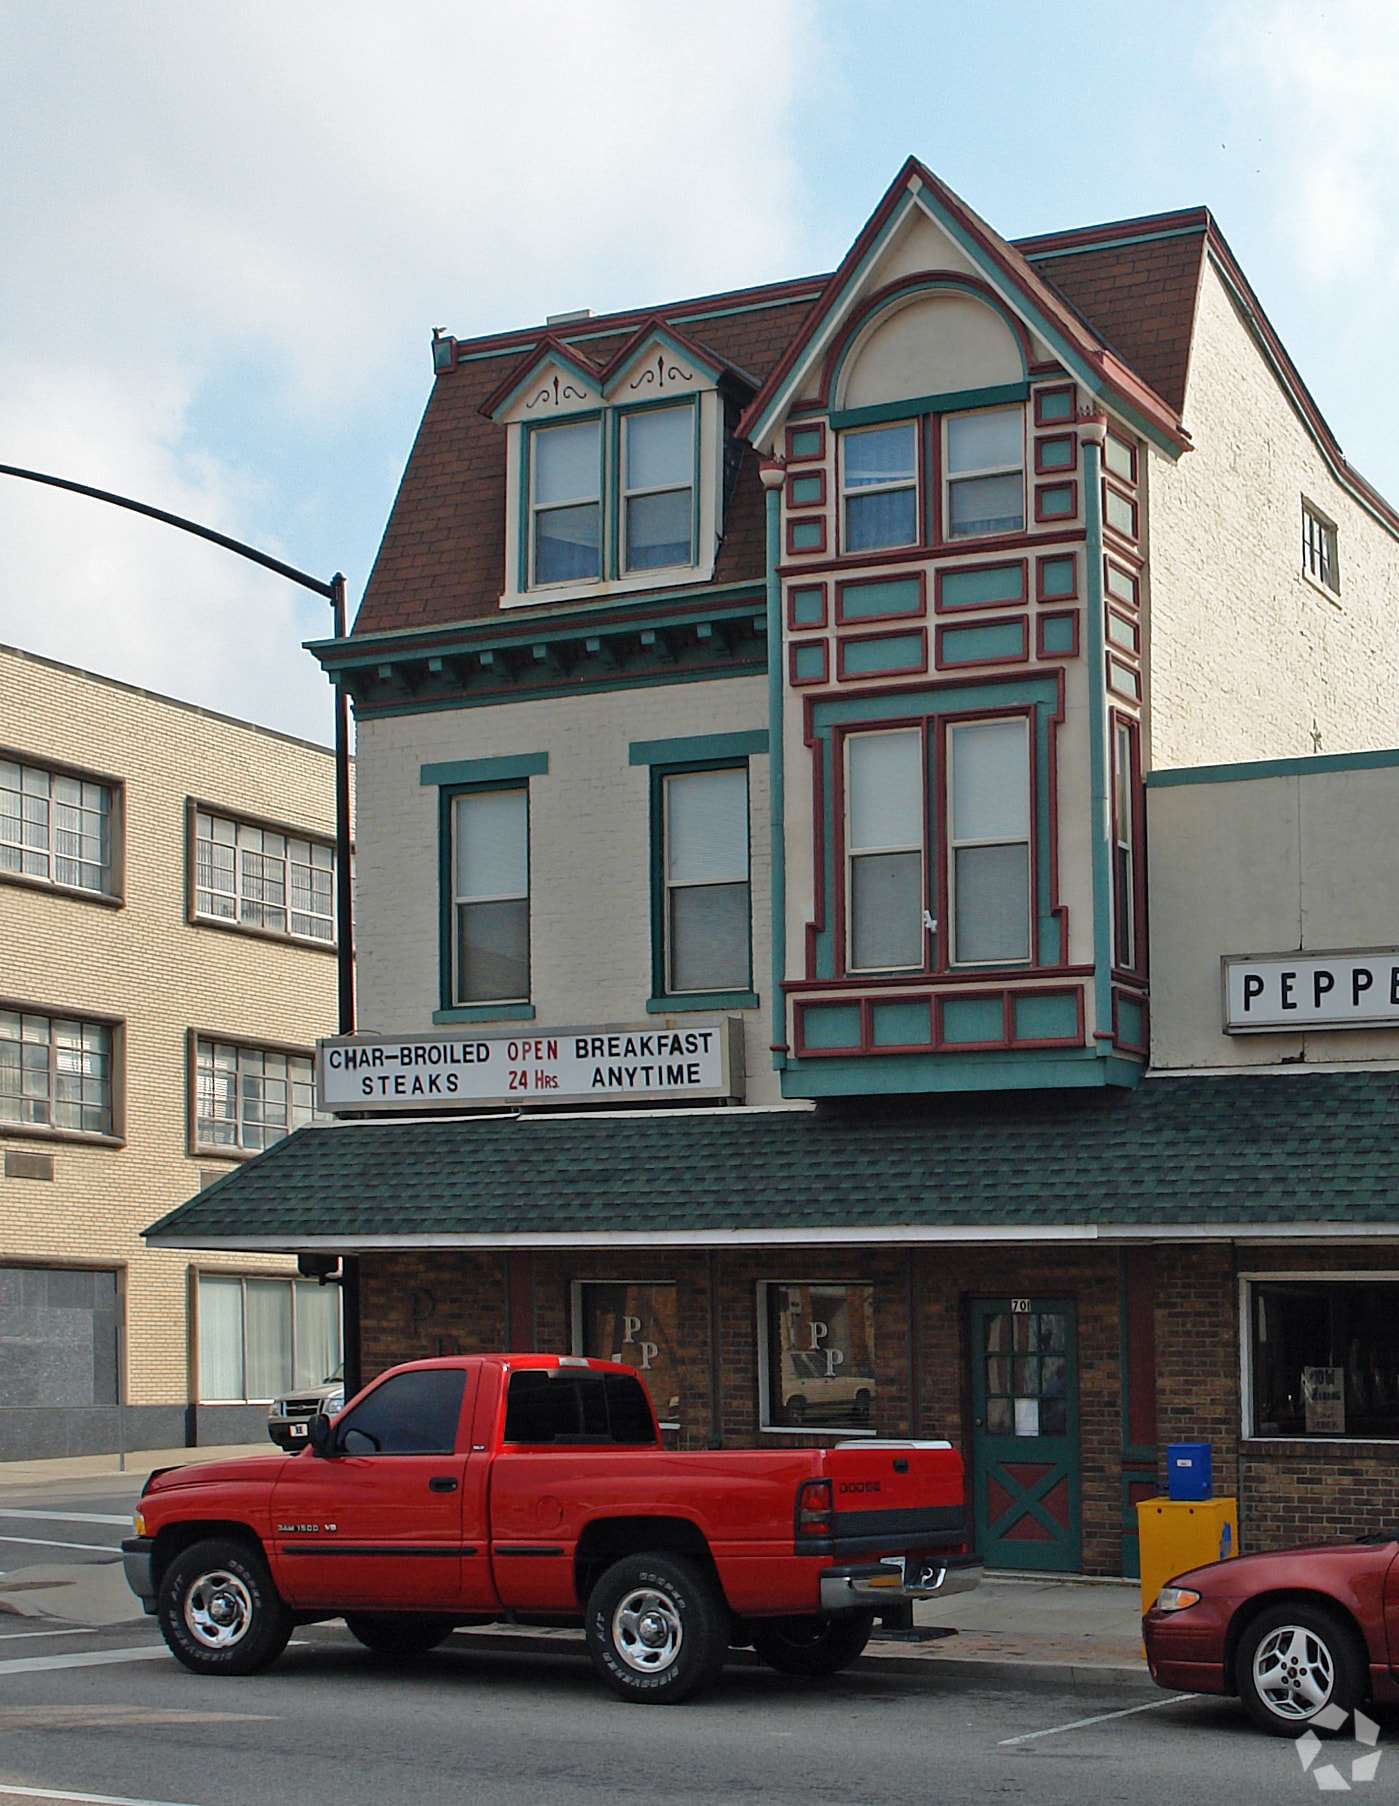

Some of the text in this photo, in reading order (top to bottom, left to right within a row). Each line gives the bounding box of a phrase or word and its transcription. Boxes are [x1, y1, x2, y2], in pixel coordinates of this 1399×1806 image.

[329, 1042, 490, 1070] CHAR-BROILED
[507, 1039, 559, 1061] OPEN
[575, 1032, 713, 1059] BREAKFAST
[361, 1073, 459, 1096] STEAKS
[508, 1070, 528, 1090] 24
[591, 1063, 701, 1088] ANYTIME
[622, 1316, 642, 1343] P
[808, 1321, 828, 1349] P
[639, 1342, 659, 1369] P
[823, 1348, 844, 1376] P
